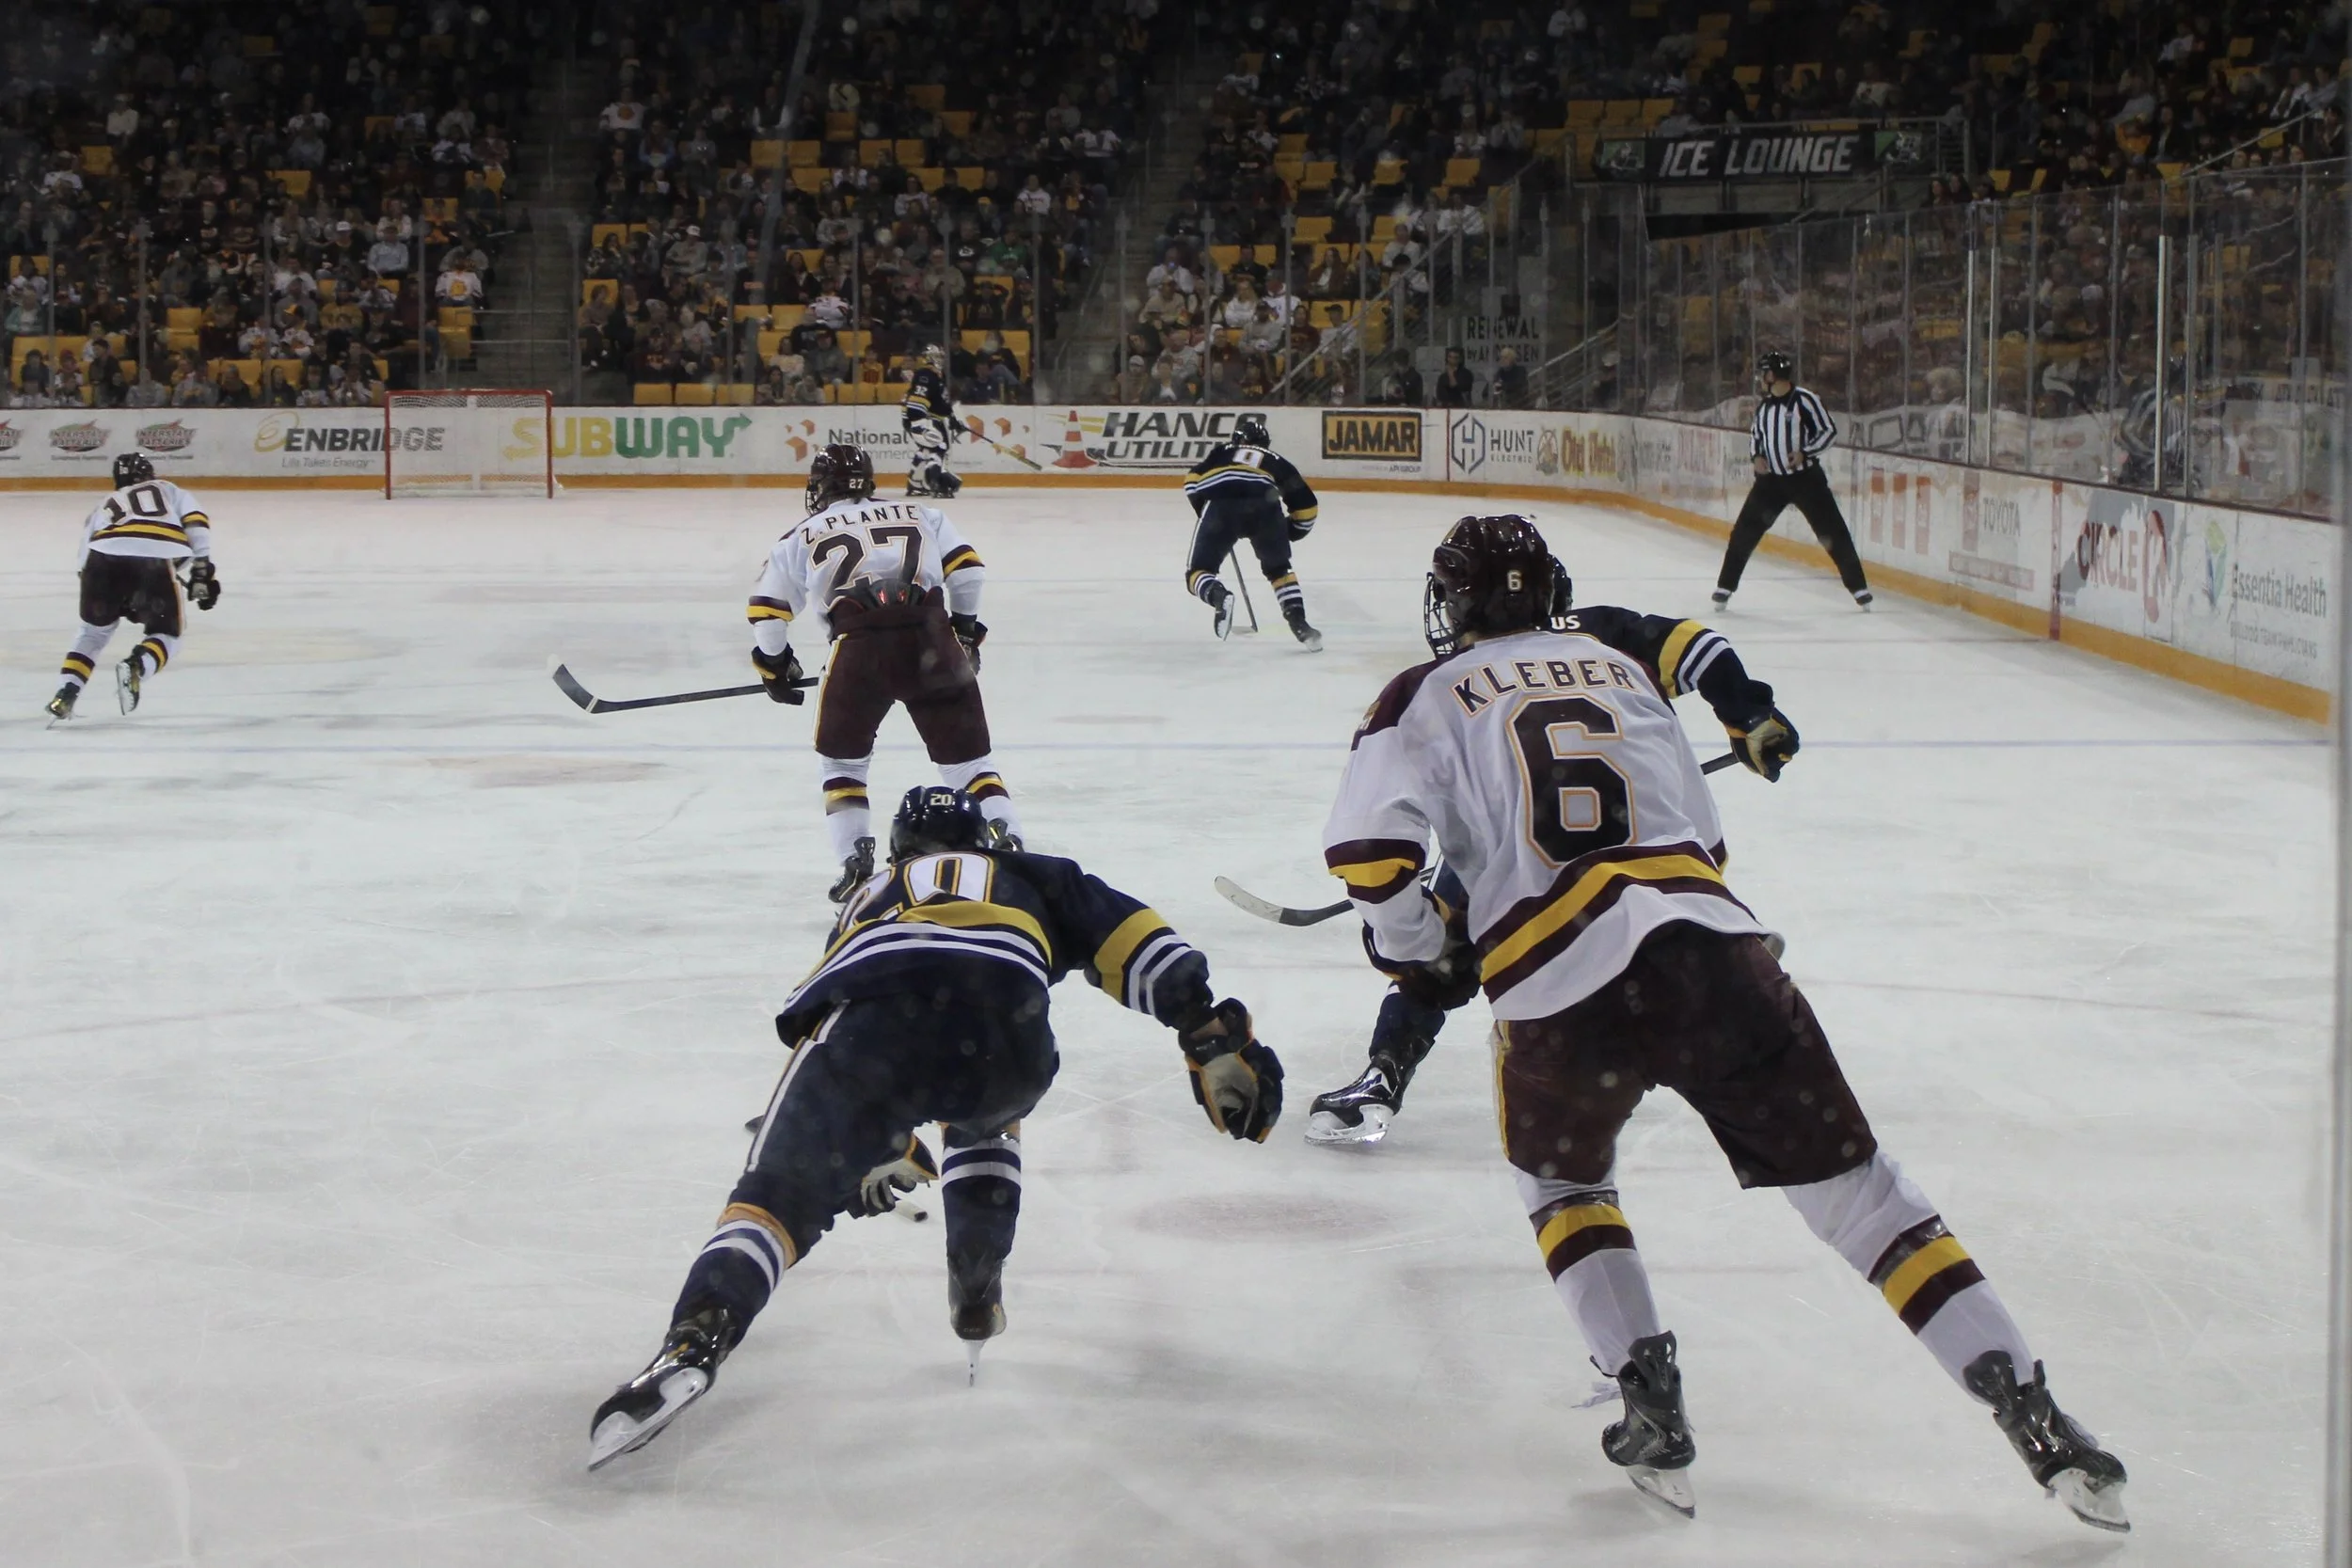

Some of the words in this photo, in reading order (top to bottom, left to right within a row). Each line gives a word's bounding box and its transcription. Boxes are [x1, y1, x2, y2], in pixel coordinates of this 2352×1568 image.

[1659, 141, 1715, 178] ICE
[1724, 135, 1860, 177] LOUNGE
[1466, 315, 1541, 340] RENEWAL
[914, 385, 929, 395] 32
[284, 427, 445, 451] ENBRIDGE
[502, 413, 752, 461] SUBWAY
[828, 429, 909, 445] National
[1106, 440, 1225, 459] UTILIT
[1327, 420, 1416, 453] JAMAR
[1490, 429, 1534, 453] HUNT
[1490, 454, 1534, 464] ELECTRIC
[848, 478, 865, 490] 27
[103, 483, 168, 524] 10
[1982, 496, 2021, 537] TOYOTA
[801, 527, 824, 546] Z.
[825, 504, 919, 531] PLANTE
[811, 524, 924, 610] 27
[1507, 568, 1523, 593] 6
[2233, 563, 2282, 609] Essentia
[2284, 573, 2327, 618] Health
[1452, 658, 1639, 718] KLEBER
[1506, 692, 1638, 869] 6
[930, 793, 953, 806] 20
